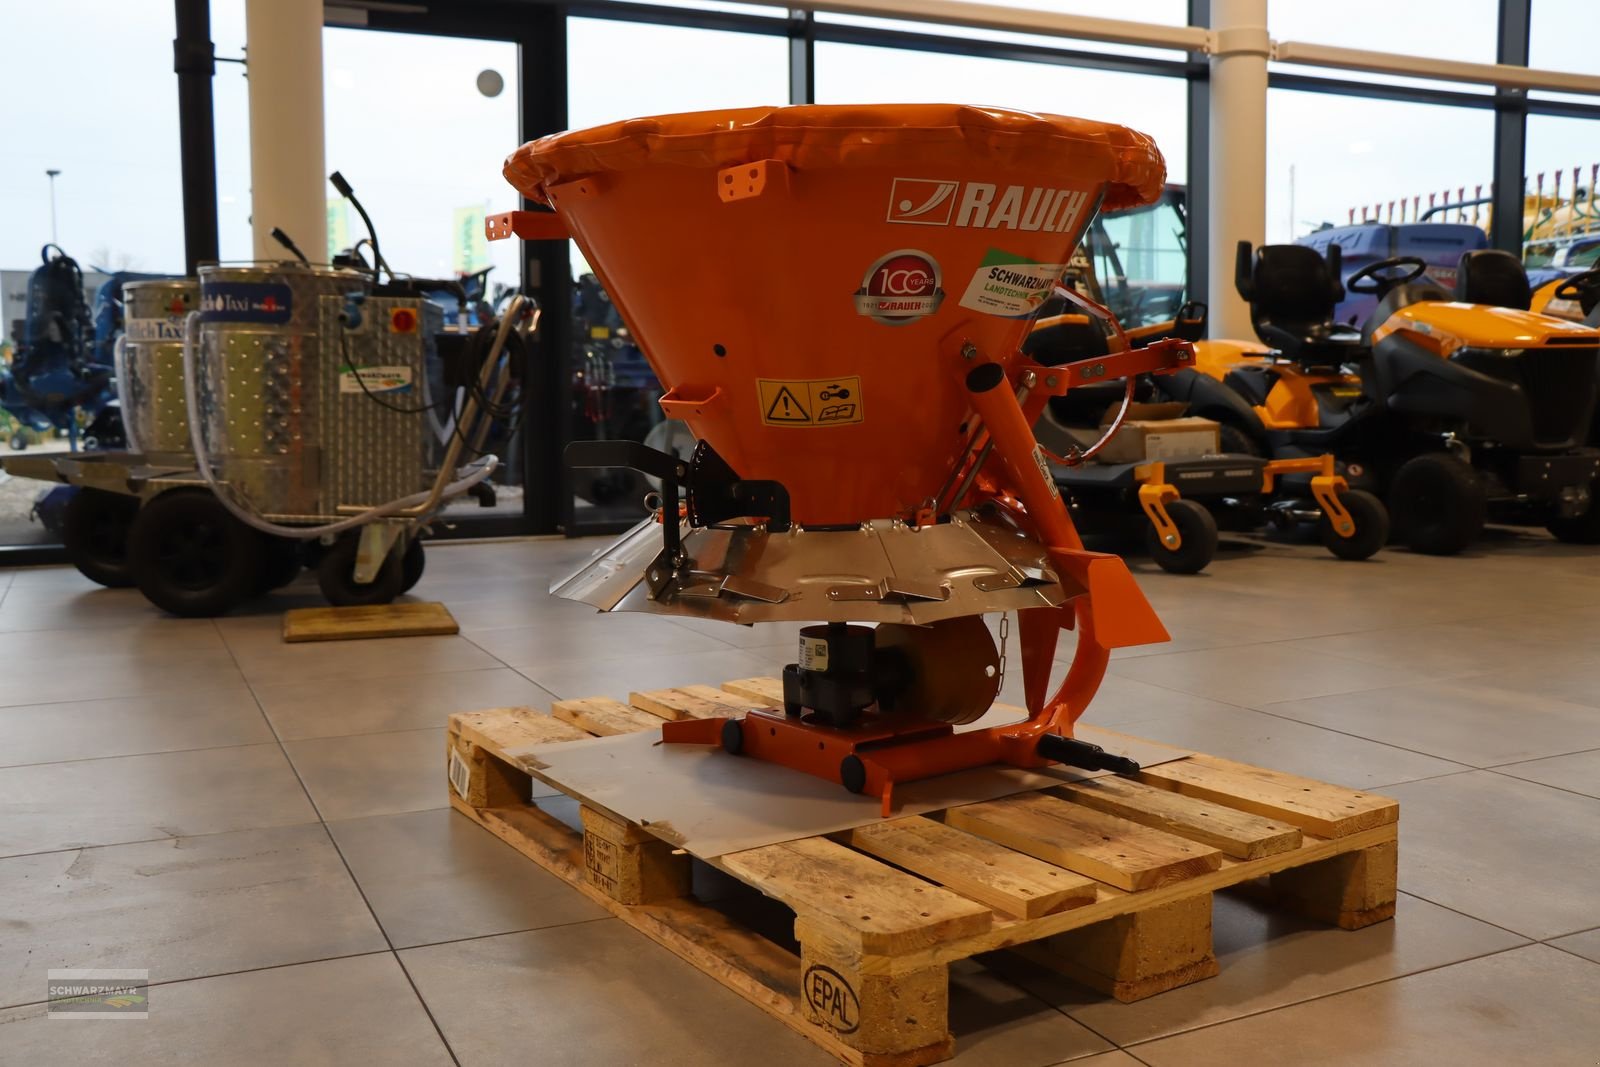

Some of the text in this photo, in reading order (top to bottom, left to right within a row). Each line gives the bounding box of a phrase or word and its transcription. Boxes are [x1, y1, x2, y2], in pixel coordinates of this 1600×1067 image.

[955, 181, 1088, 233] RAUCH
[881, 268, 928, 295] 100
[983, 282, 1029, 300] LANDTECHNIK
[890, 301, 922, 311] RAUCH
[813, 972, 853, 1028] EPAL
